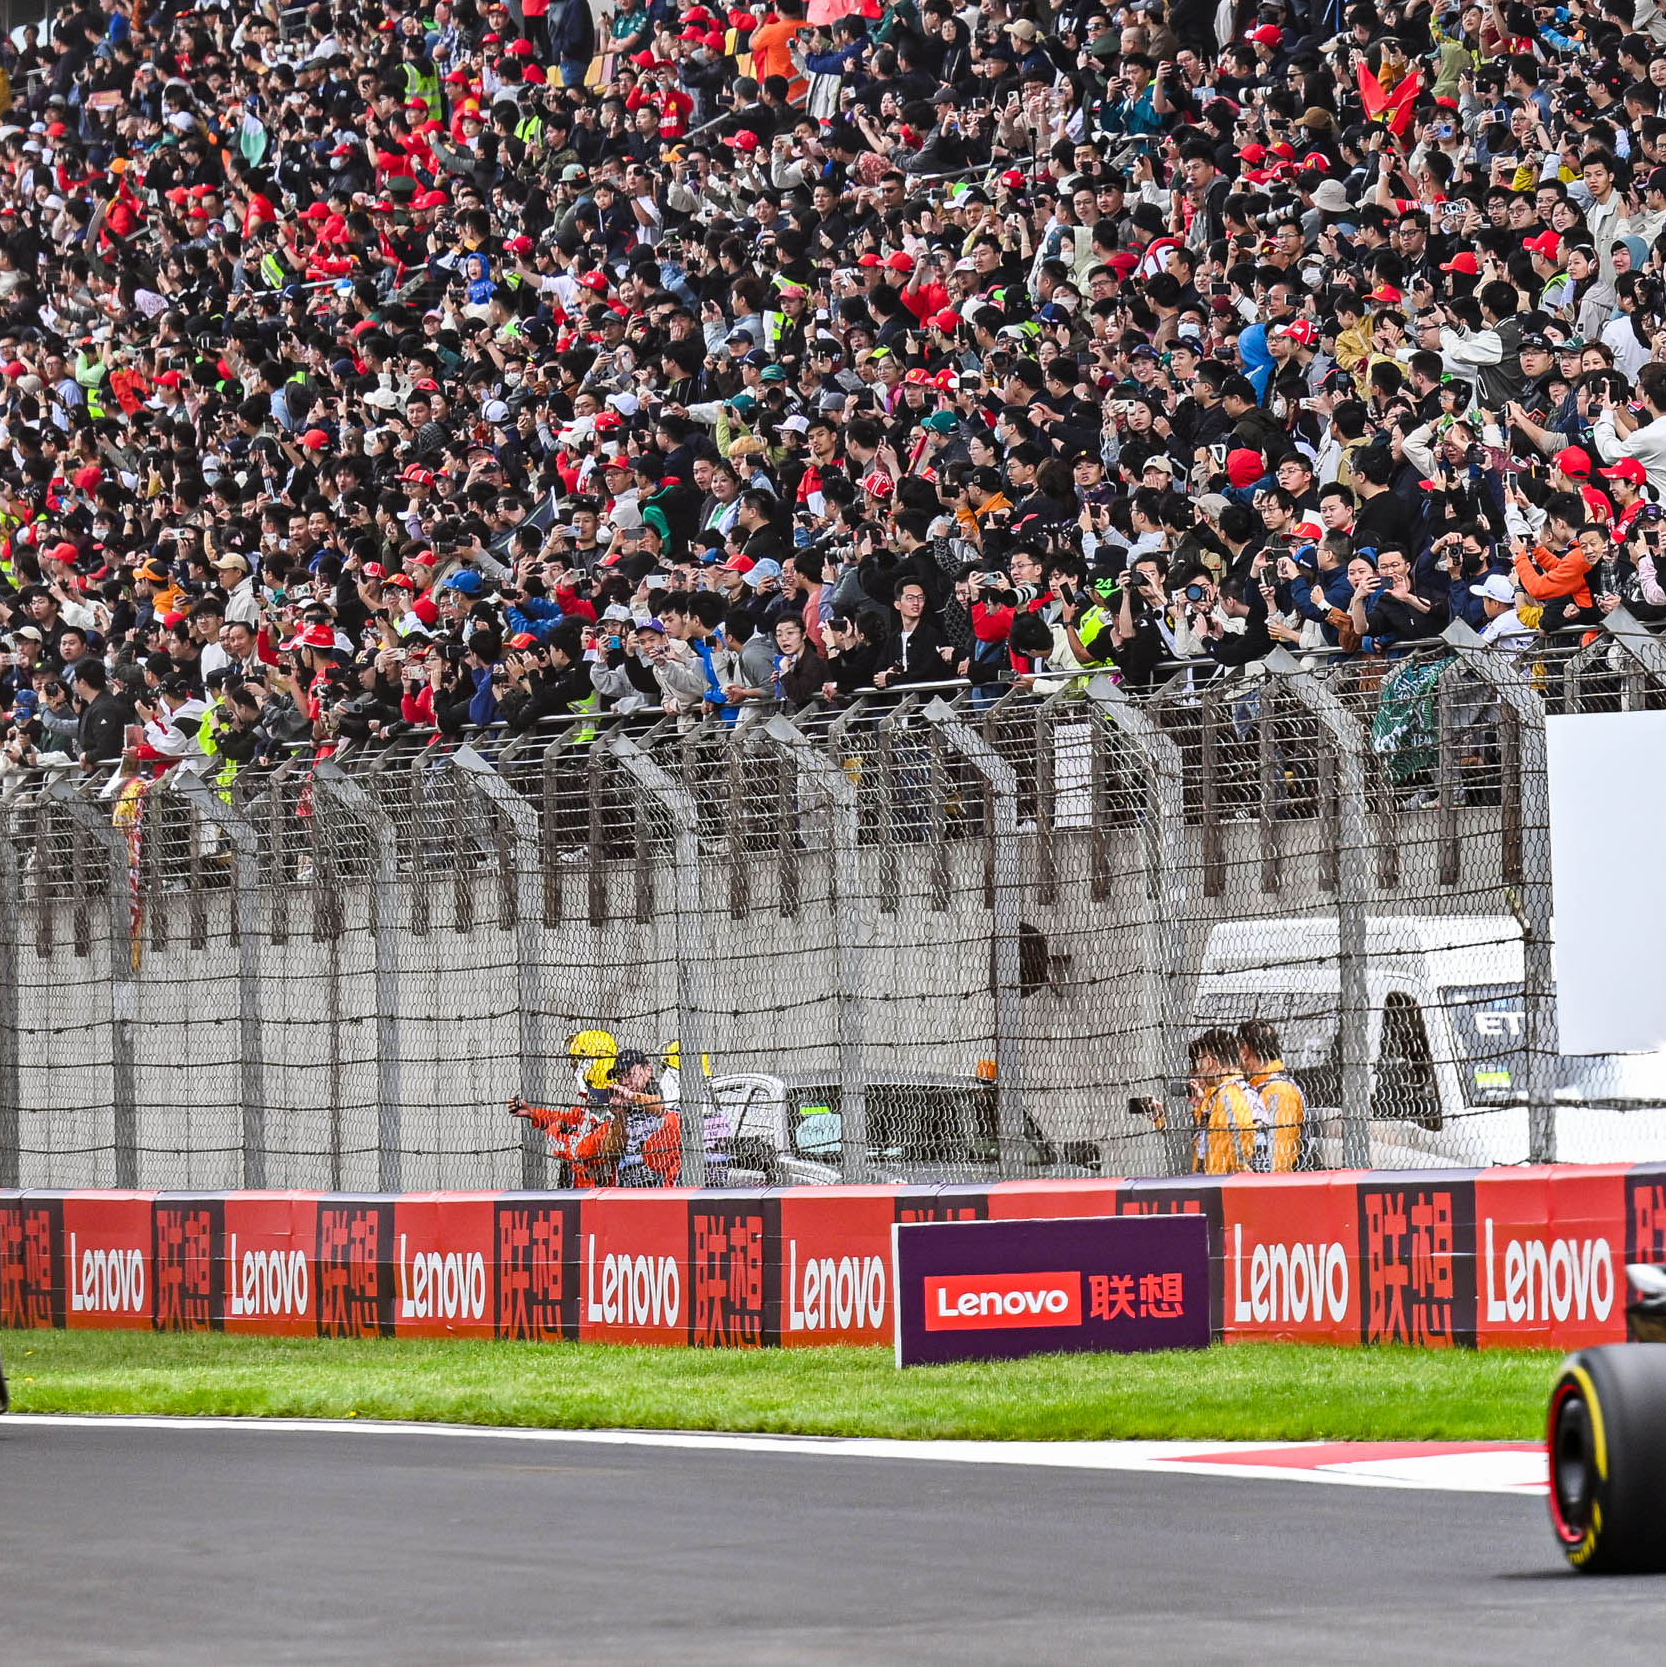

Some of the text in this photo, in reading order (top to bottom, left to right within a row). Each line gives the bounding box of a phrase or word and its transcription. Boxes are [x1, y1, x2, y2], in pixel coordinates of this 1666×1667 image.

[1094, 577, 1112, 589] 24
[70, 1208, 211, 1332] Lenovo 联想
[231, 1210, 380, 1338] Lenovo 联想
[400, 1209, 564, 1340] Lenovo 联想
[588, 1214, 763, 1349] Lenovo 联想
[789, 1239, 886, 1331] Lenovo
[937, 1272, 1185, 1321] Lenovo 联想
[1233, 1191, 1455, 1348] Lenovo 联想
[1485, 1217, 1615, 1323] Lenovo
